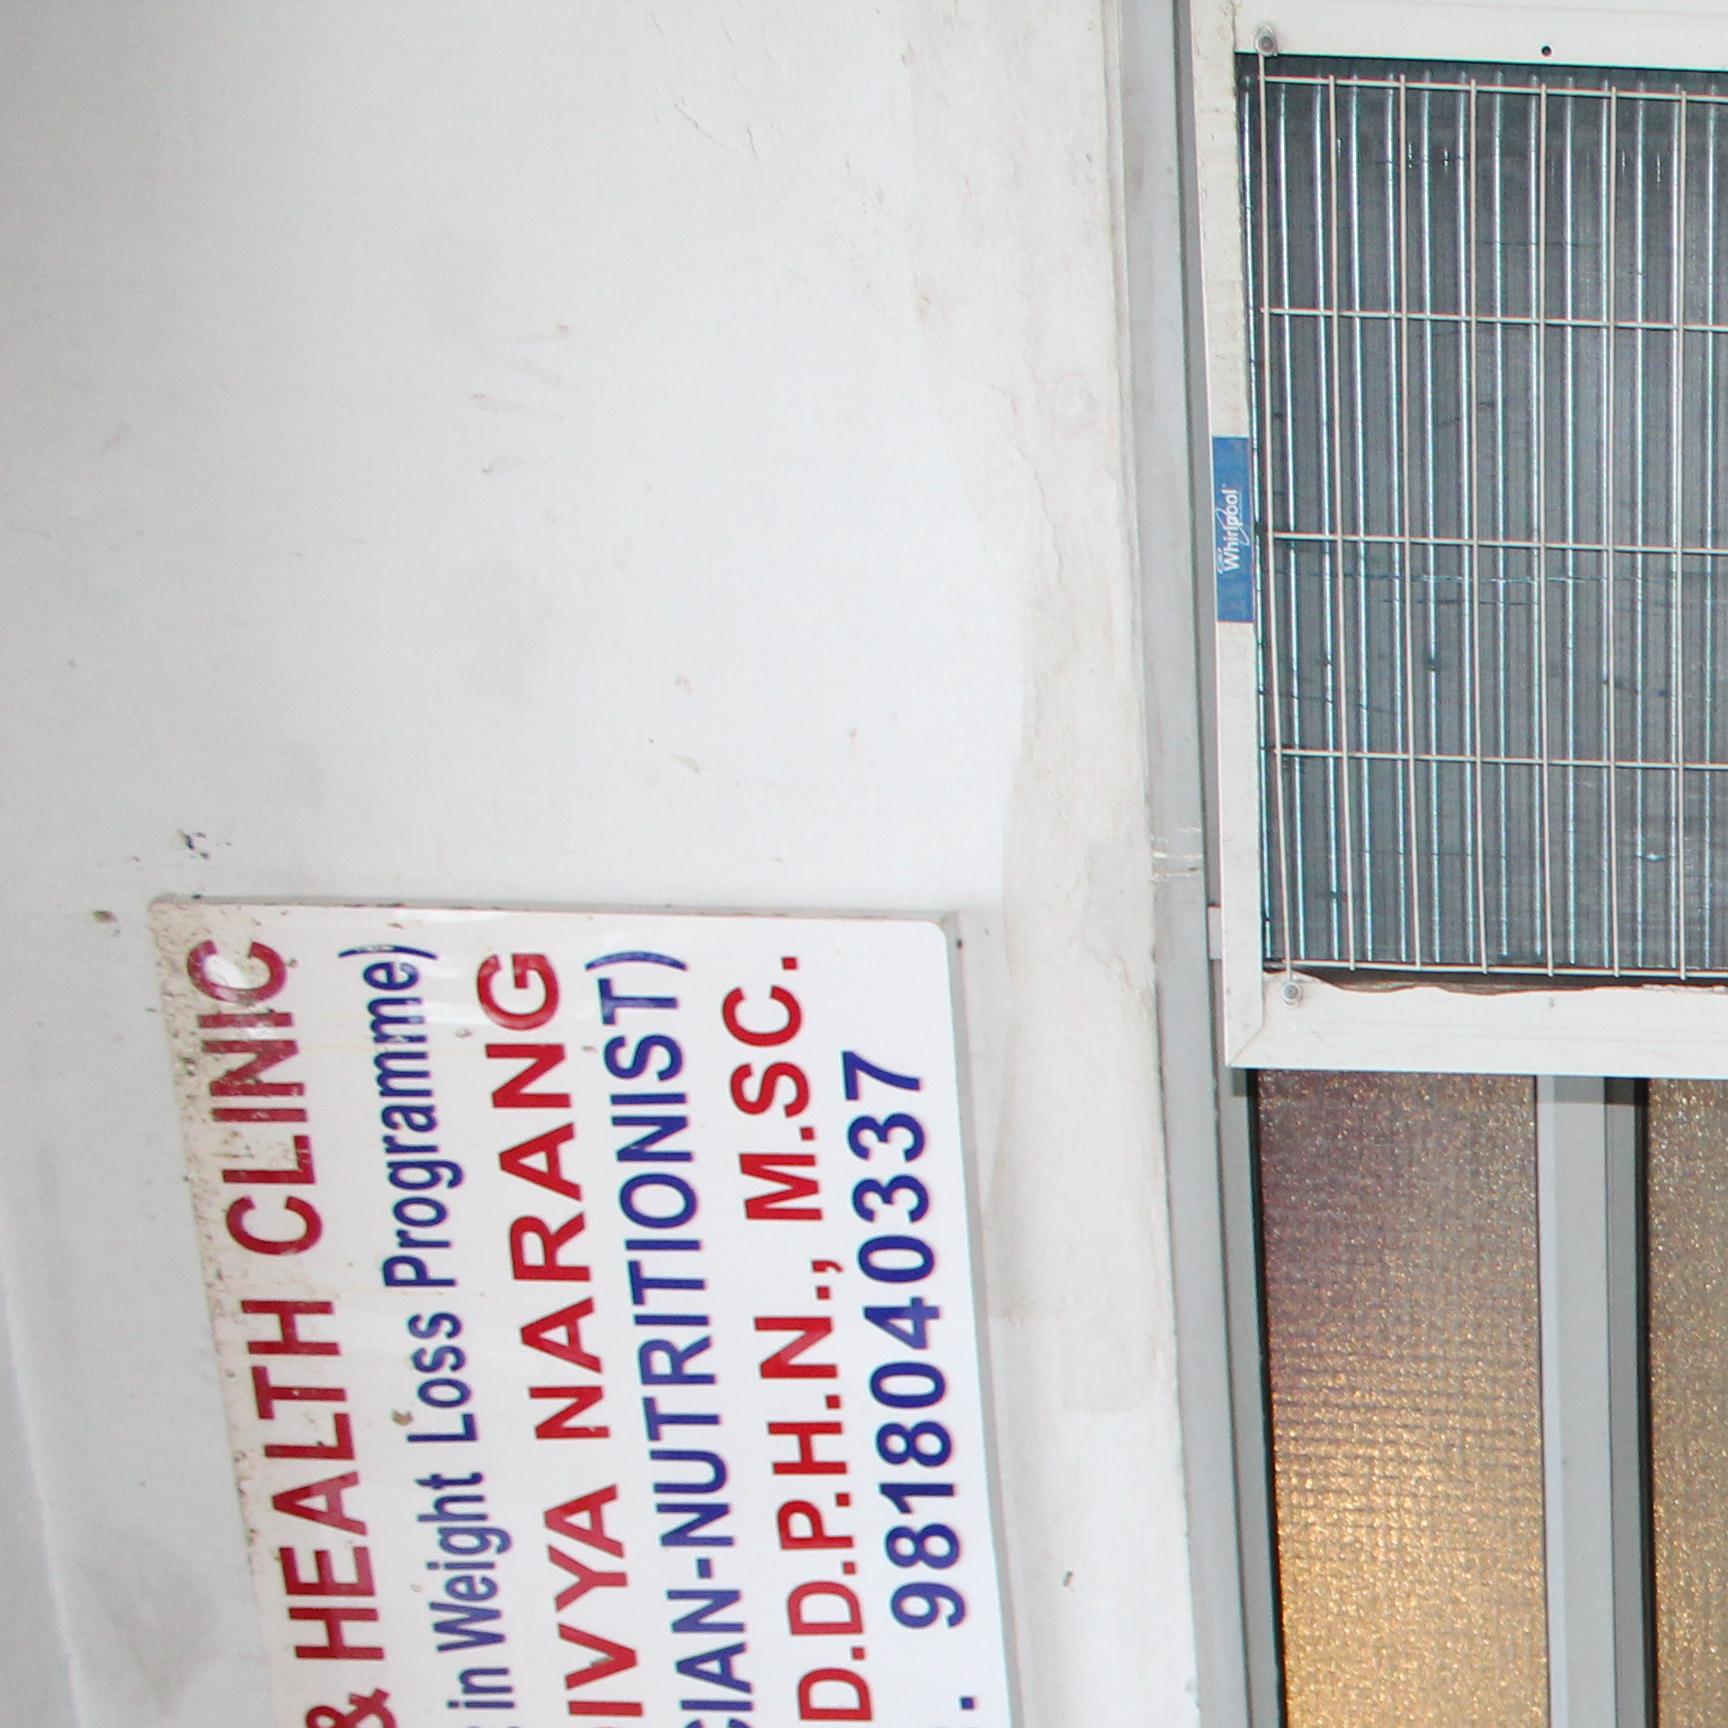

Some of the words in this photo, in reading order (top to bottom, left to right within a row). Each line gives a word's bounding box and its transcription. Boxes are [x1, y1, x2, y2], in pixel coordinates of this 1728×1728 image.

[1217, 487, 1245, 573] Whirlpool
[186, 940, 325, 1257] CLINIC
[338, 944, 465, 1289] Programme)
[474, 950, 613, 1442] NARANG
[722, 955, 825, 1223] M.SC.
[239, 1299, 386, 1662] HEALTH
[405, 1311, 479, 1443] Loss
[754, 1258, 875, 1723] D.D.P.H.N.,
[839, 1049, 966, 1628] 9818040337
[418, 1471, 514, 1653] Weight
[446, 1668, 520, 1711] in
